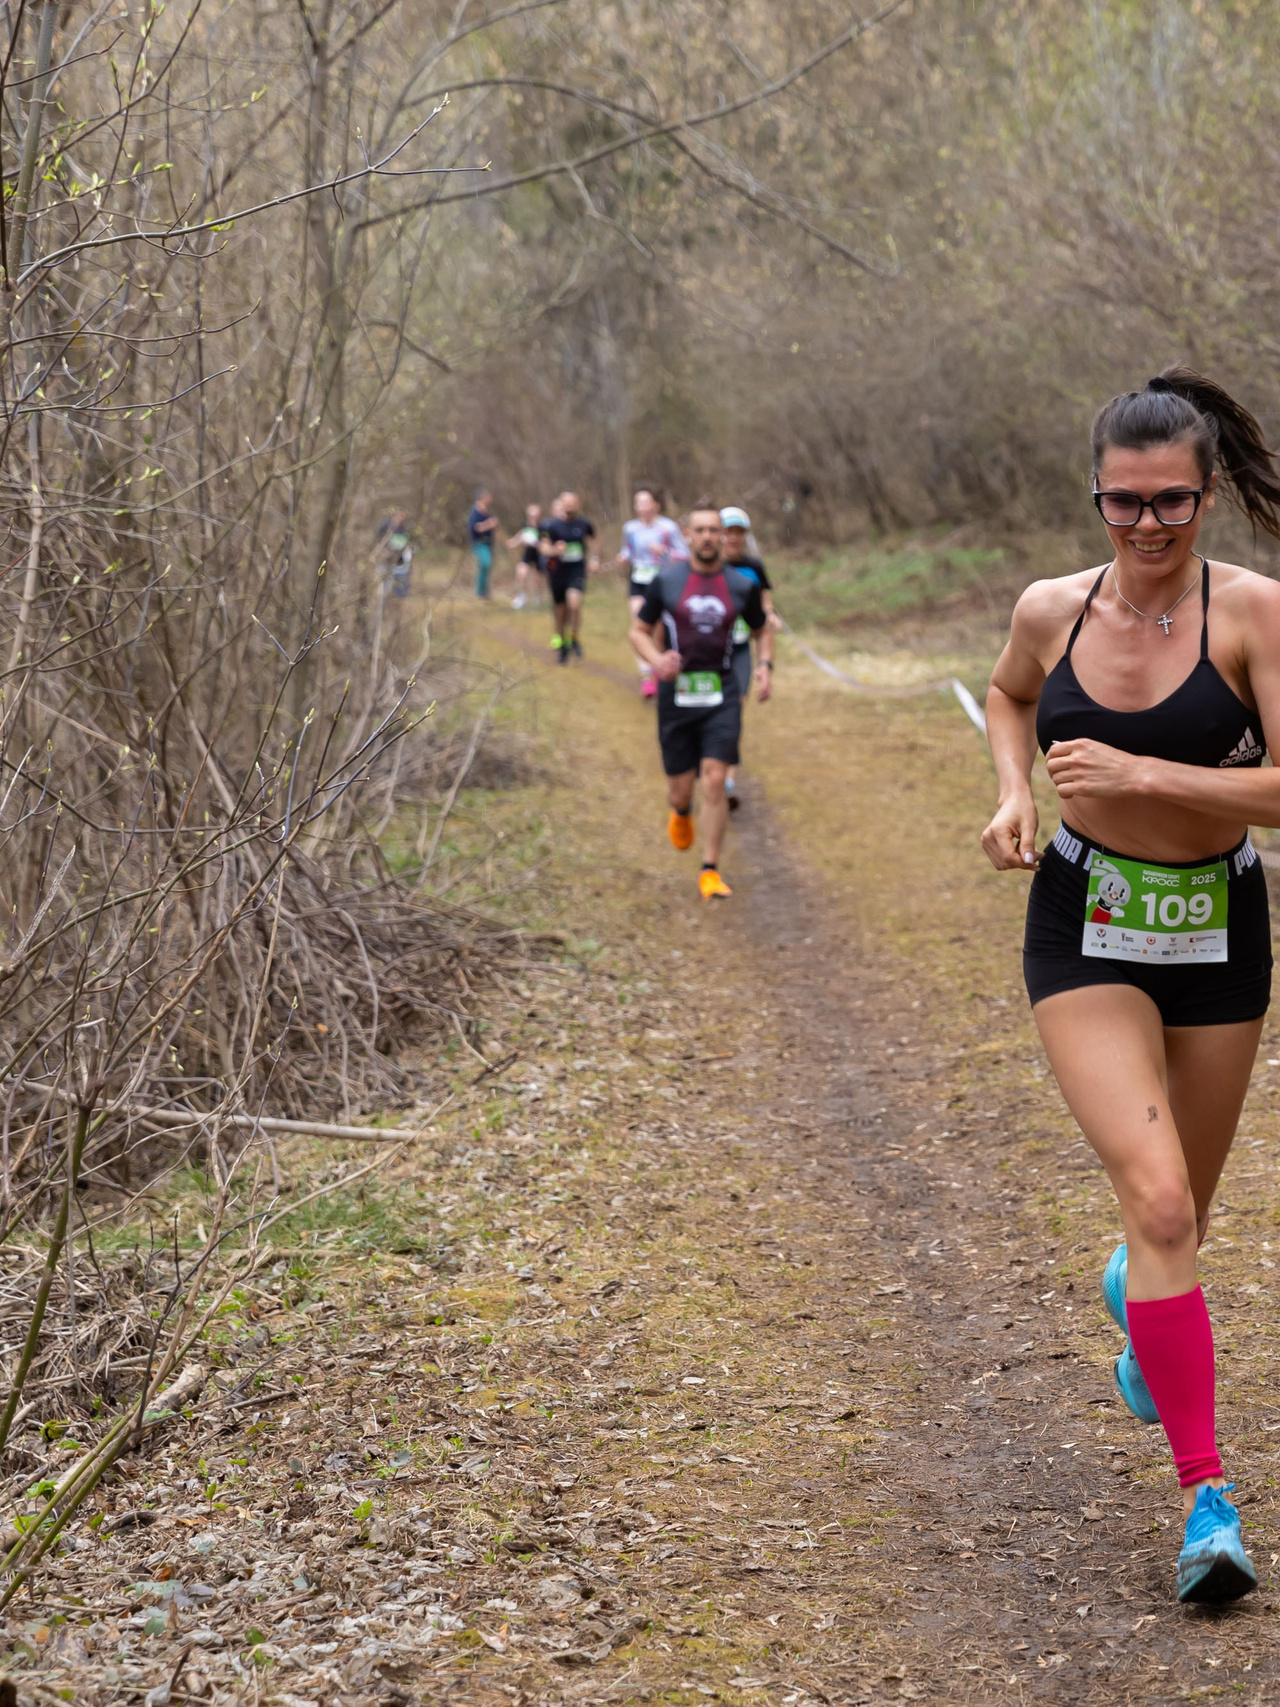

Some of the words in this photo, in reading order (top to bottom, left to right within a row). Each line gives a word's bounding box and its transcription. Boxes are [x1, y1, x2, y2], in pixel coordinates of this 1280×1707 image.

[1219, 745, 1262, 766] adidas
[1142, 875, 1180, 887] КРОСС
[1191, 872, 1217, 885] 2025
[1141, 892, 1213, 927] 109
